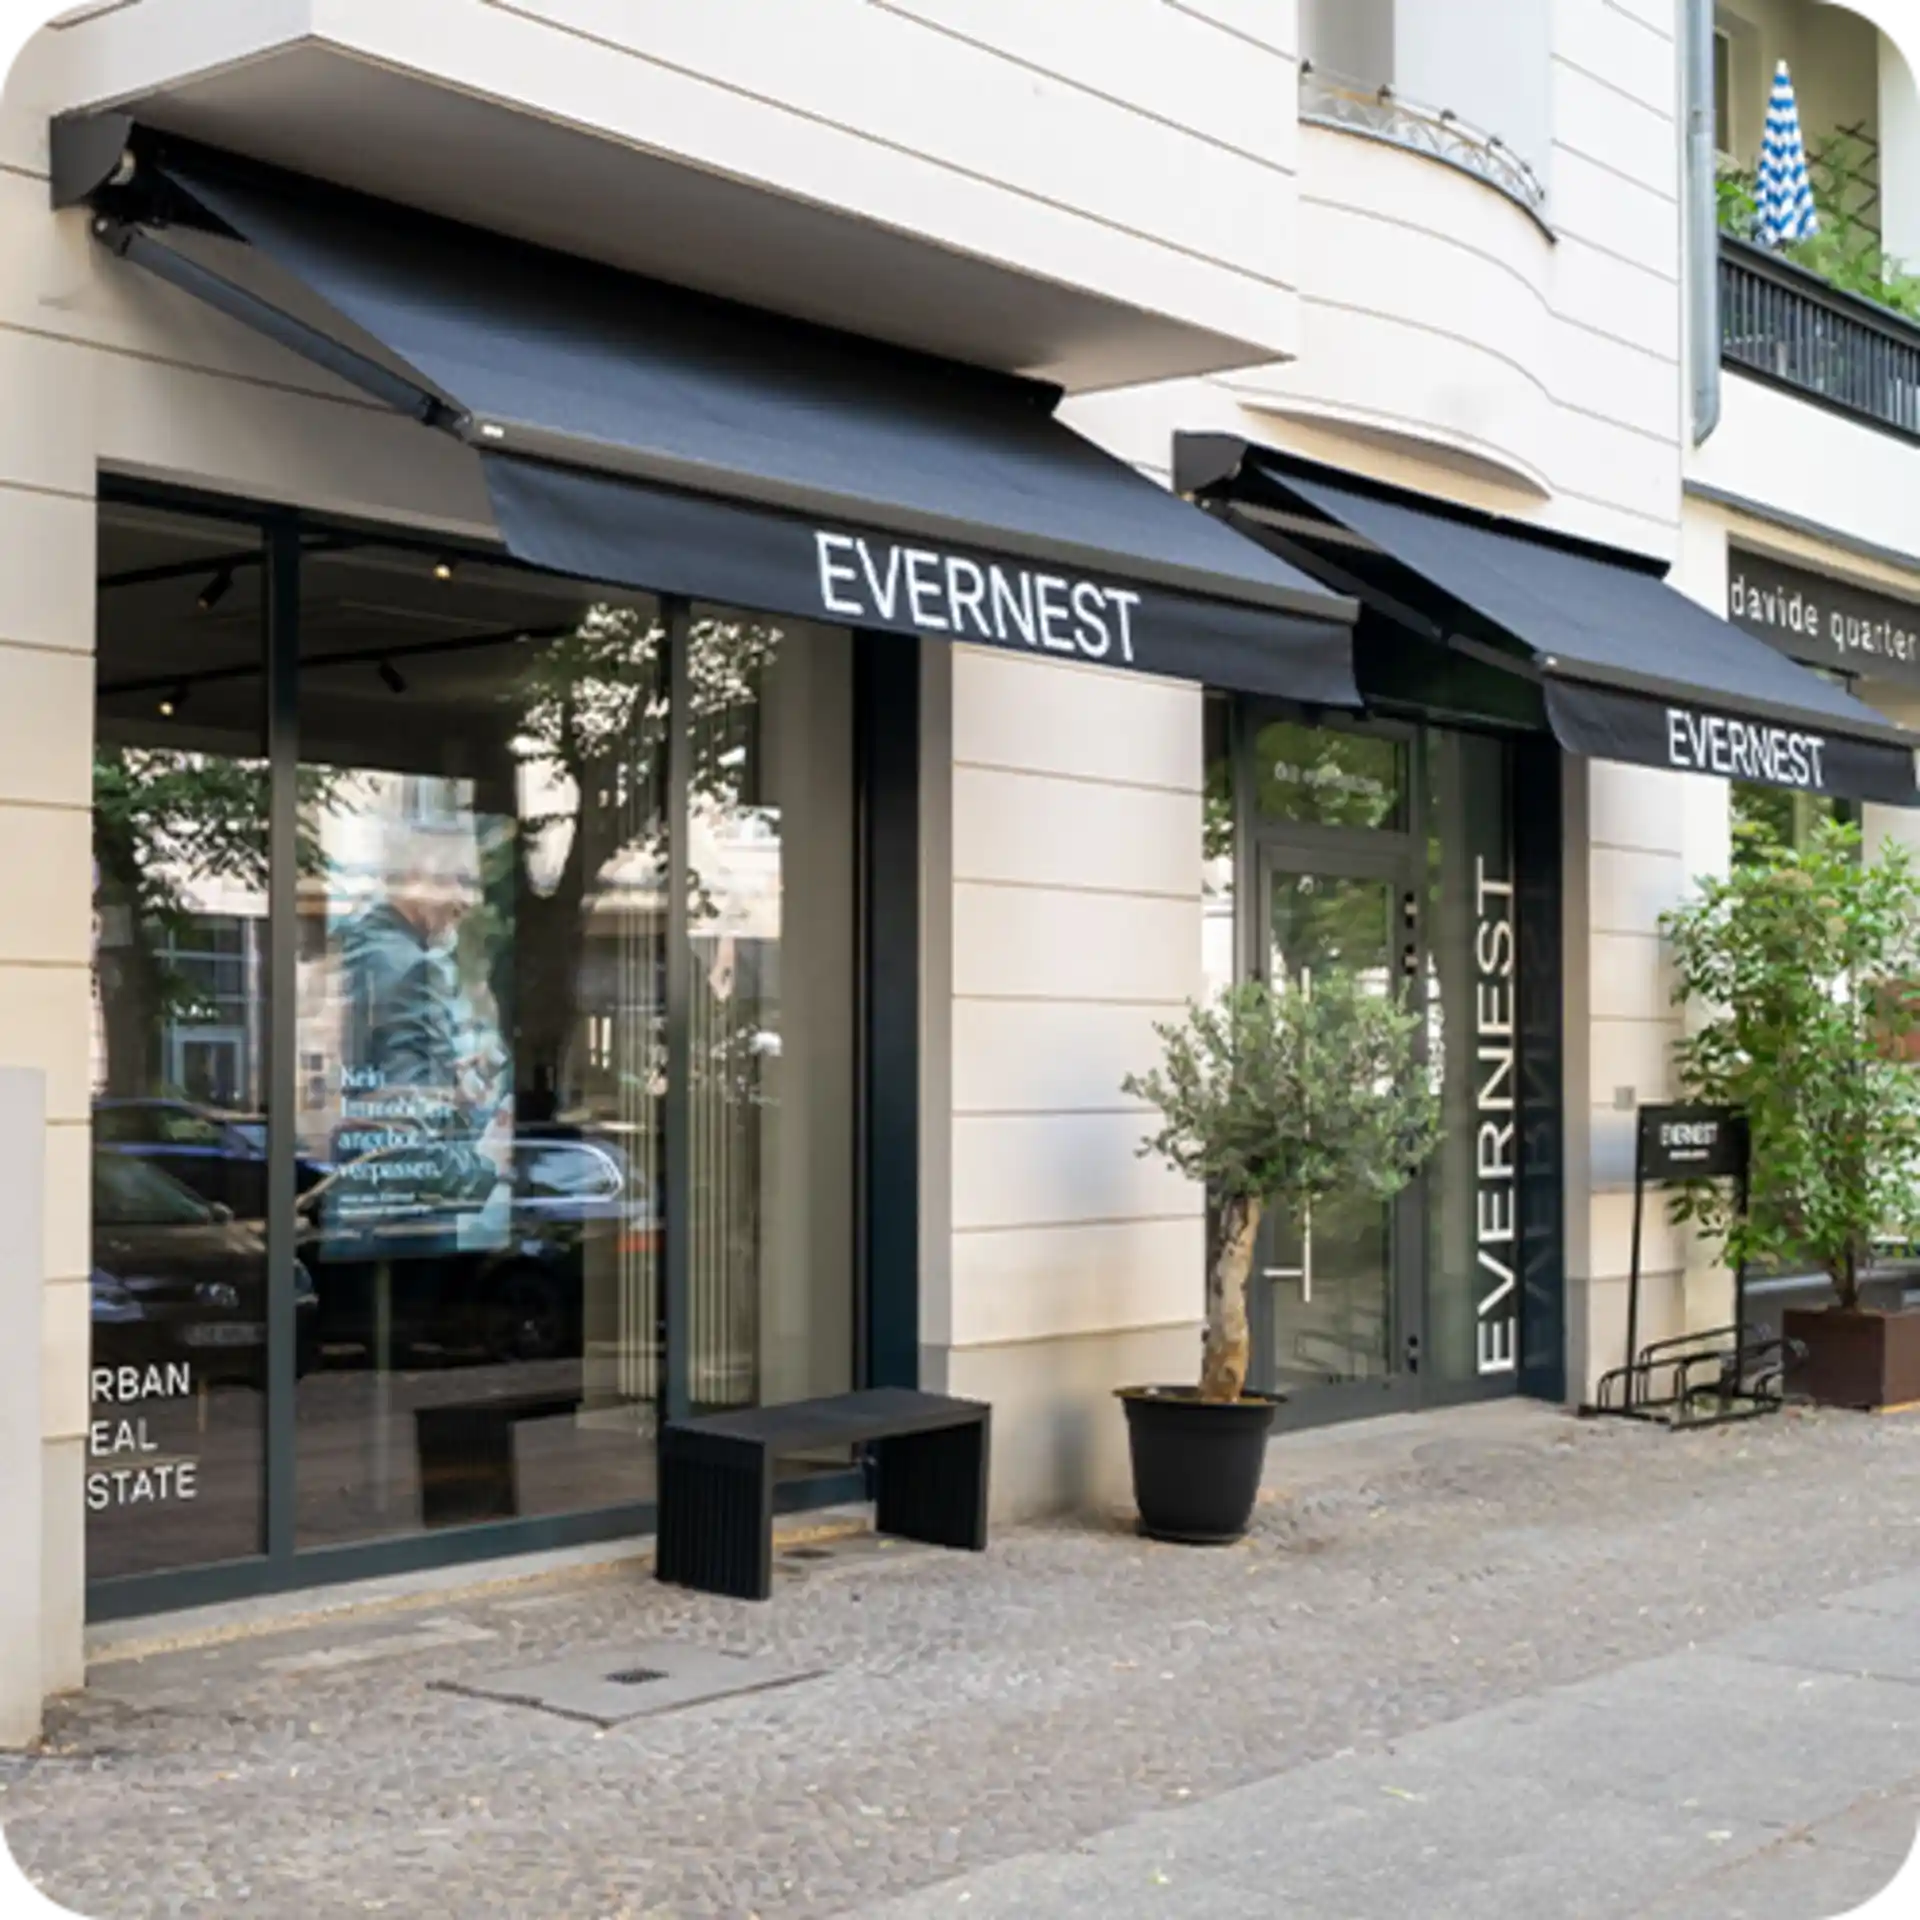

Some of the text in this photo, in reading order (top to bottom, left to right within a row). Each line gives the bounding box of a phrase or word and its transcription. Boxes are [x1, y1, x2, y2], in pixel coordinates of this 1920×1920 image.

[815, 530, 1141, 662] EVERNEST
[1730, 575, 1819, 636] davide
[1666, 708, 1826, 788] EVERNEST
[1476, 855, 1515, 1375] EVERNEST
[91, 1362, 190, 1402] RBAN
[91, 1417, 158, 1456] EAL
[87, 1462, 198, 1510] STATE
